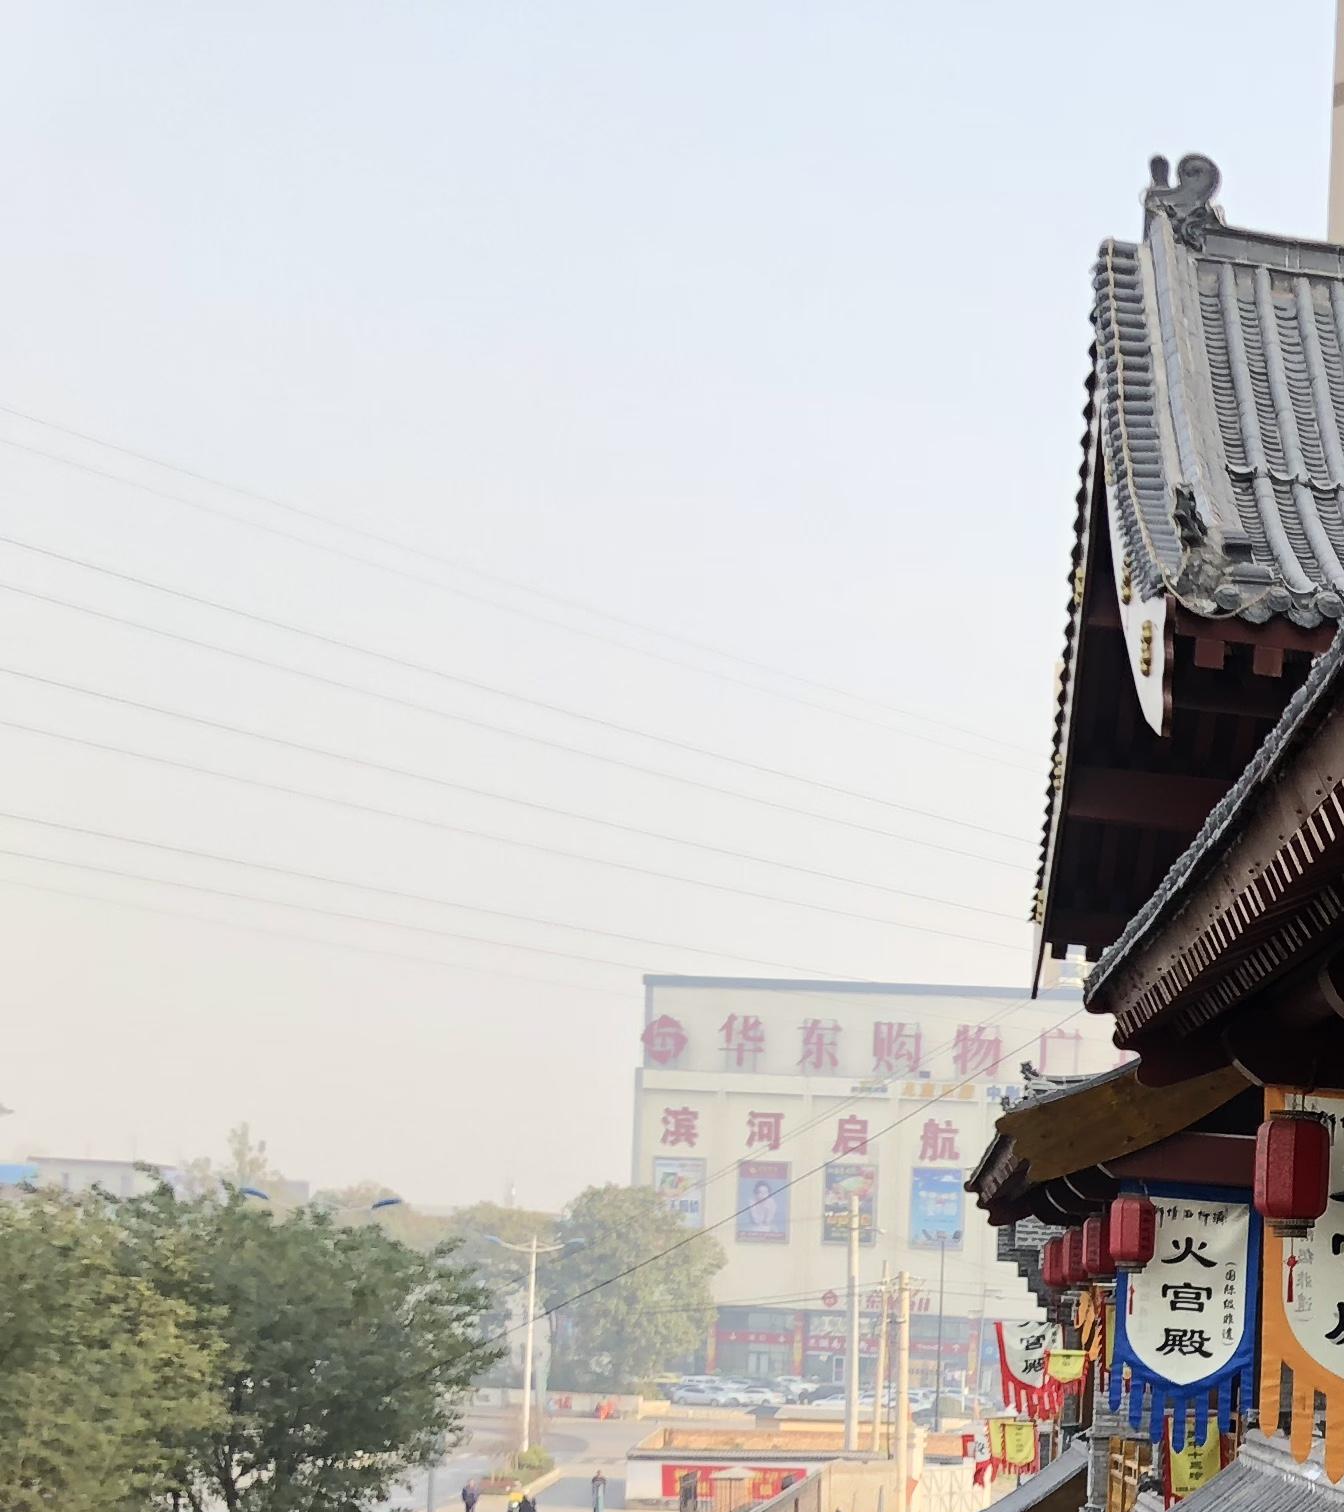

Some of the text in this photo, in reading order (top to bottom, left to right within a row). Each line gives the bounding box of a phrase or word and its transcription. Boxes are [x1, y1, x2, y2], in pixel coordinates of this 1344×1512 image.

[718, 1013, 1127, 1076] 华东购物广
[661, 1106, 960, 1161] 滨河启航
[1156, 1237, 1218, 1358] 火宫殿
